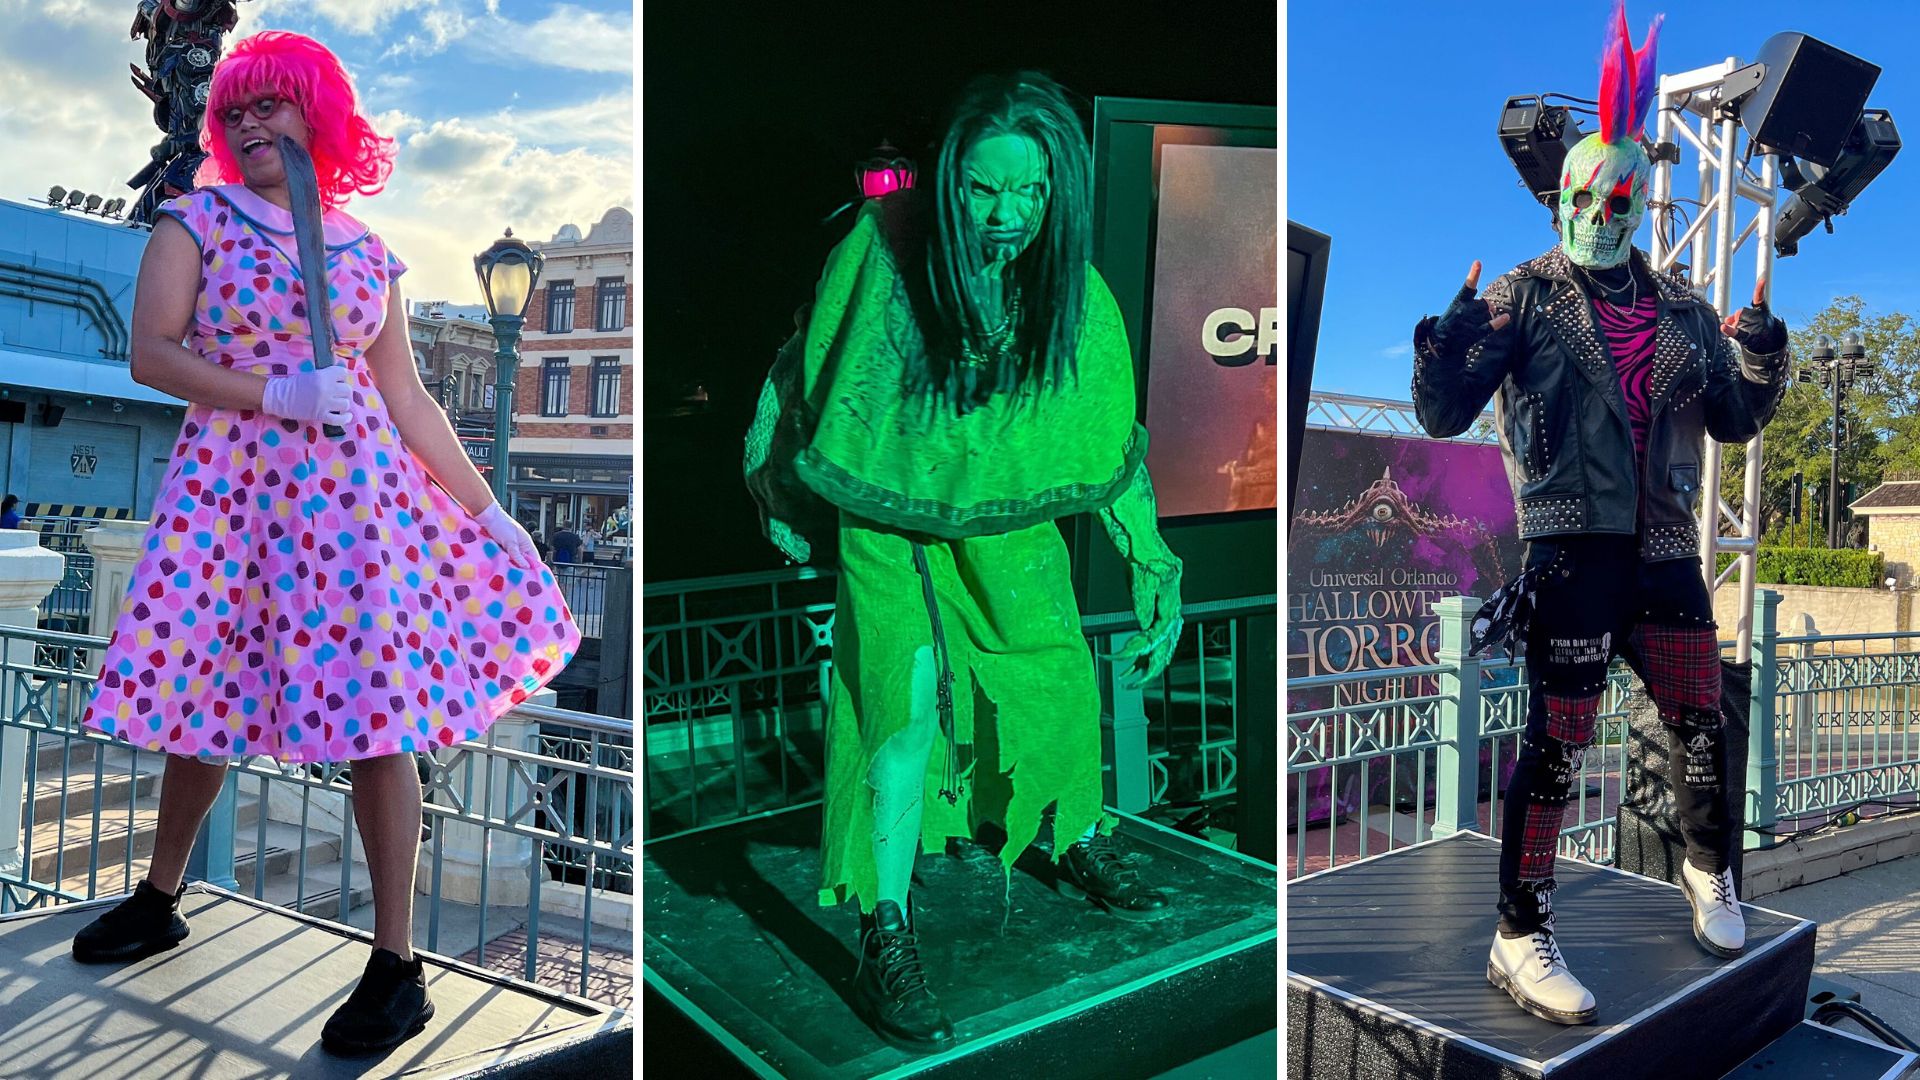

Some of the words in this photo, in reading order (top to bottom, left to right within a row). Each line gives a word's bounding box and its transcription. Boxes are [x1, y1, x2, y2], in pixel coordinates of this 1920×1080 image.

[73, 445, 95, 455] NEST
[73, 456, 79, 467] 7
[90, 457, 96, 468] 7
[1310, 568, 1384, 587] Universal
[1390, 567, 1457, 586] Orlando
[1287, 590, 1480, 623] HALLOWE
